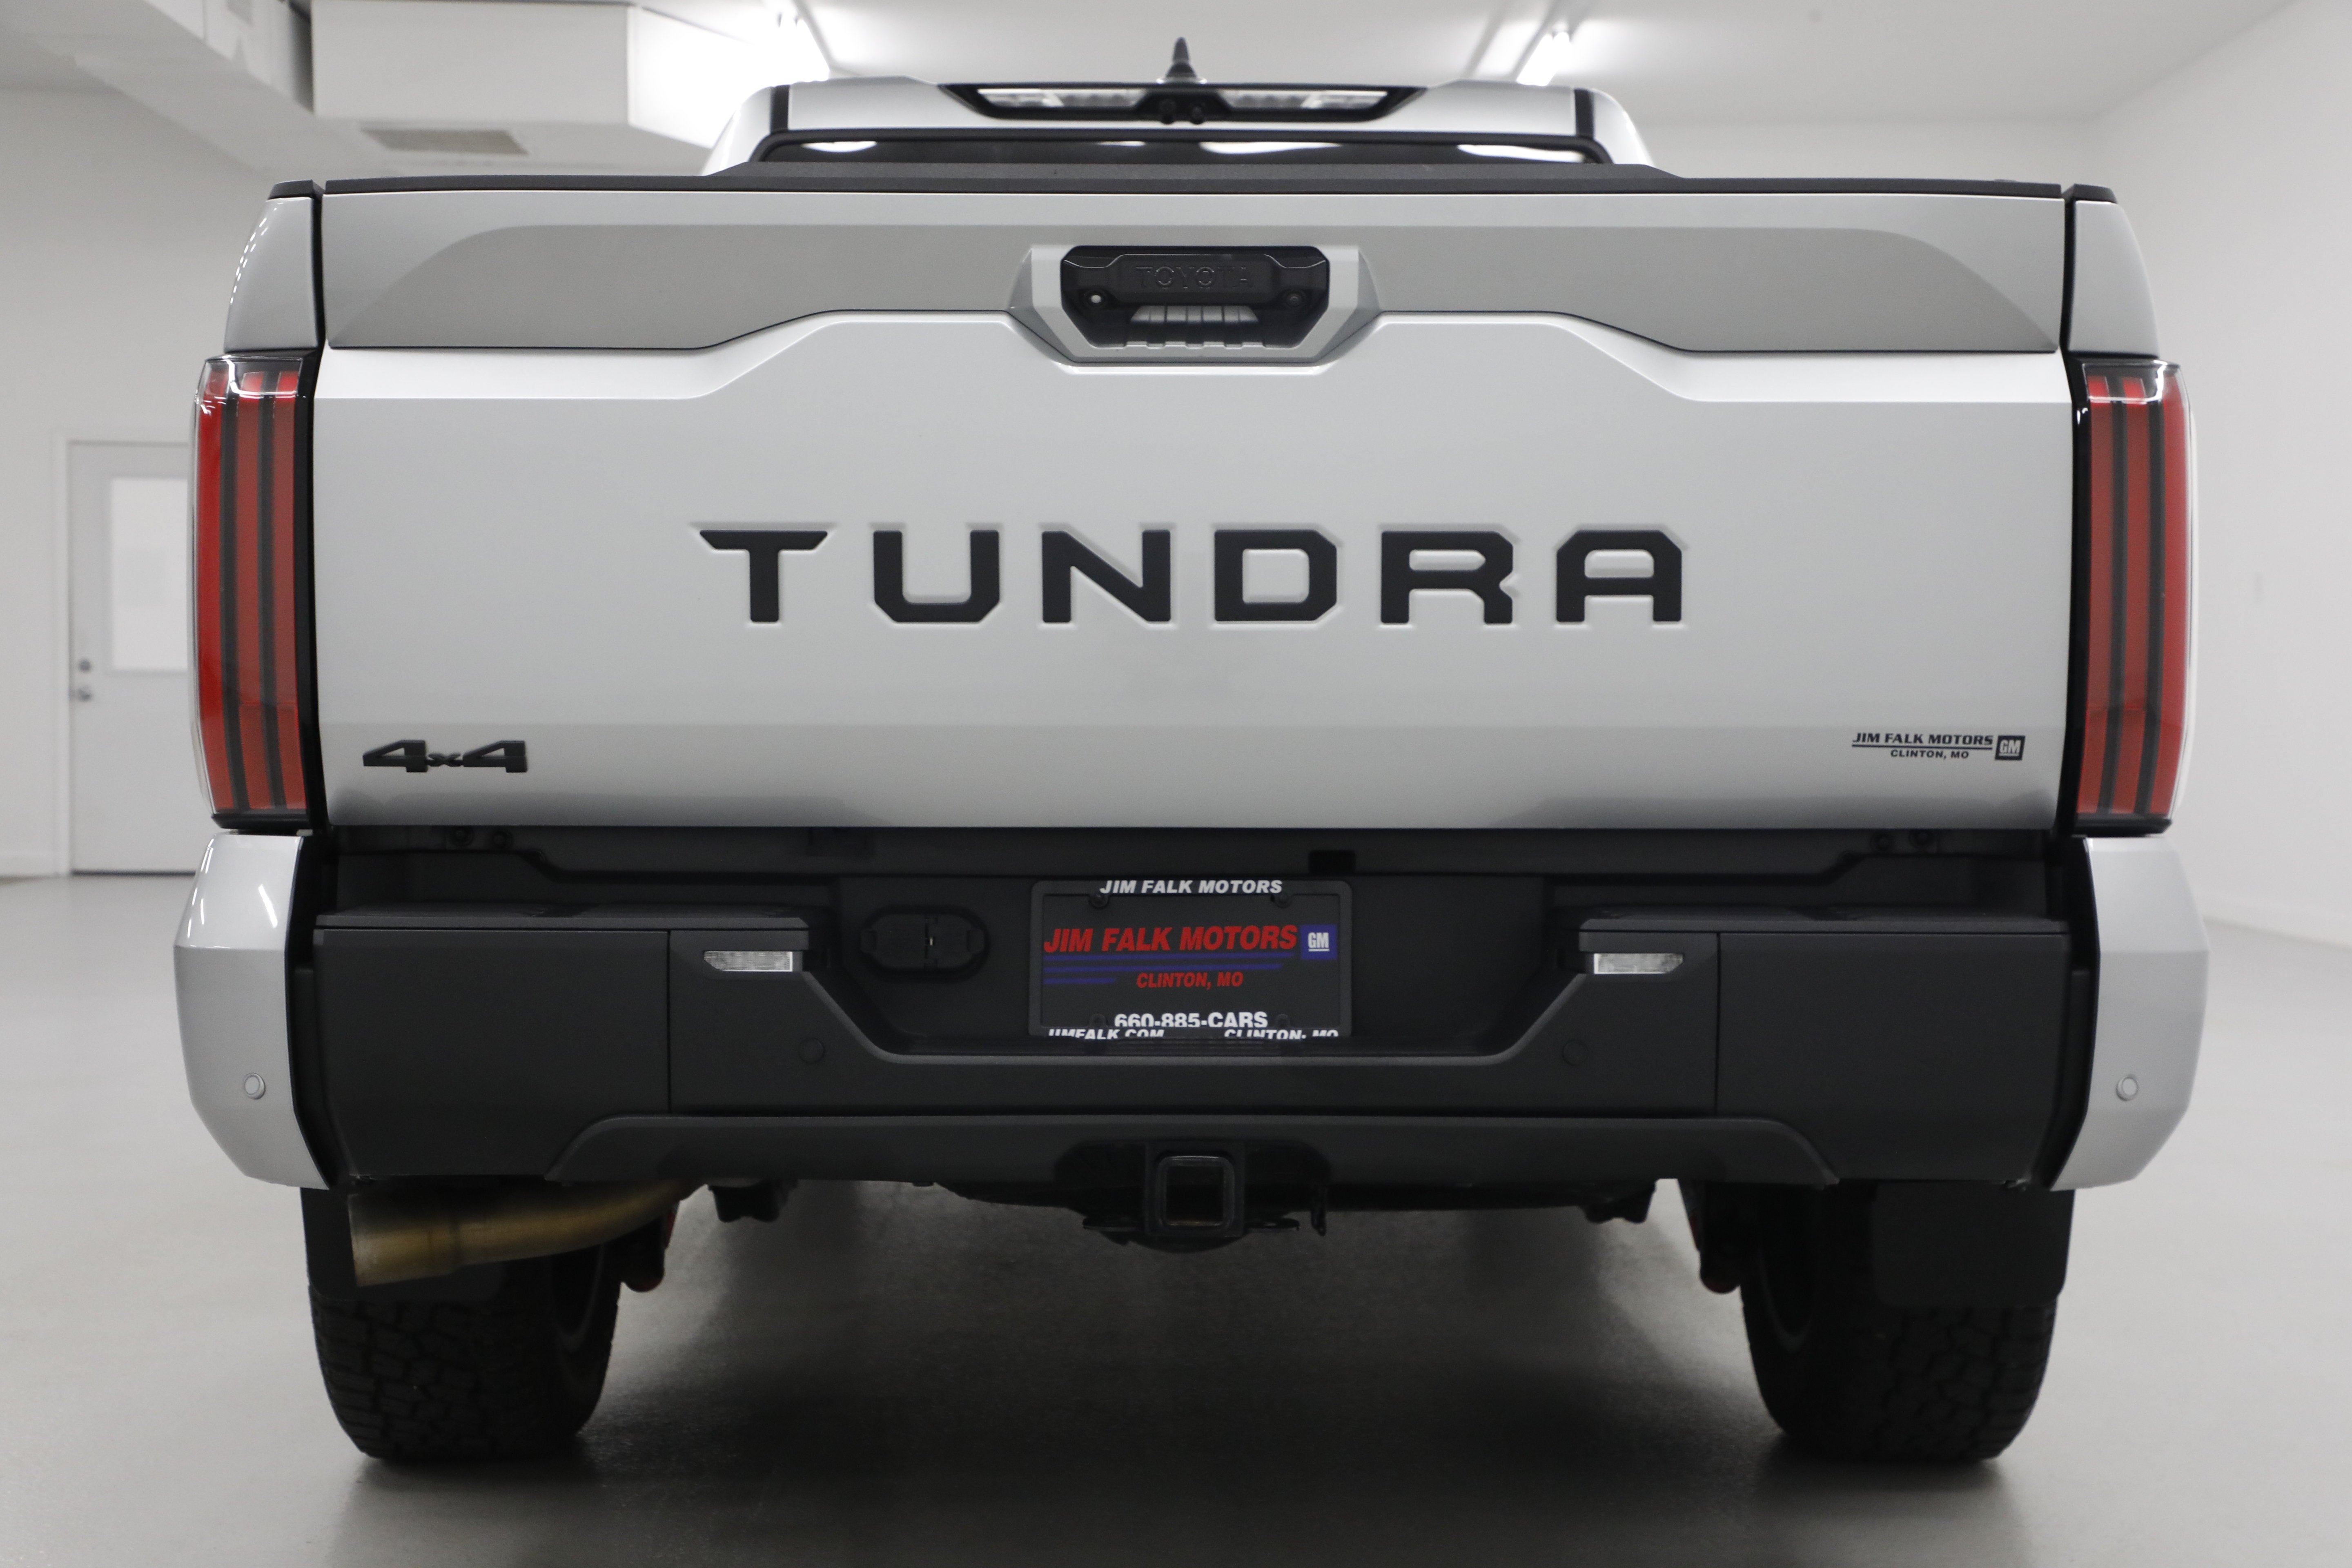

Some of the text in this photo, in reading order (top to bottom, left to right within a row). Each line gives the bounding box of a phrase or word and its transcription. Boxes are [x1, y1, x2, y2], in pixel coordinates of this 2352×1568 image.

[1136, 265, 1253, 289] TOYOTA
[699, 530, 1683, 625] TUNDRA
[1852, 733, 1993, 745] JIM FALK MOTORS
[2000, 739, 2020, 753] GM
[1890, 749, 1969, 759] CLINTON, MO
[1100, 880, 1283, 894] JIM FALK MOTORS
[1043, 924, 1298, 953] JIM FALK MOTORS
[1307, 932, 1330, 949] GM
[1136, 971, 1244, 990] CLINTON, MO
[1114, 1011, 1268, 1028] 660-885-CARS
